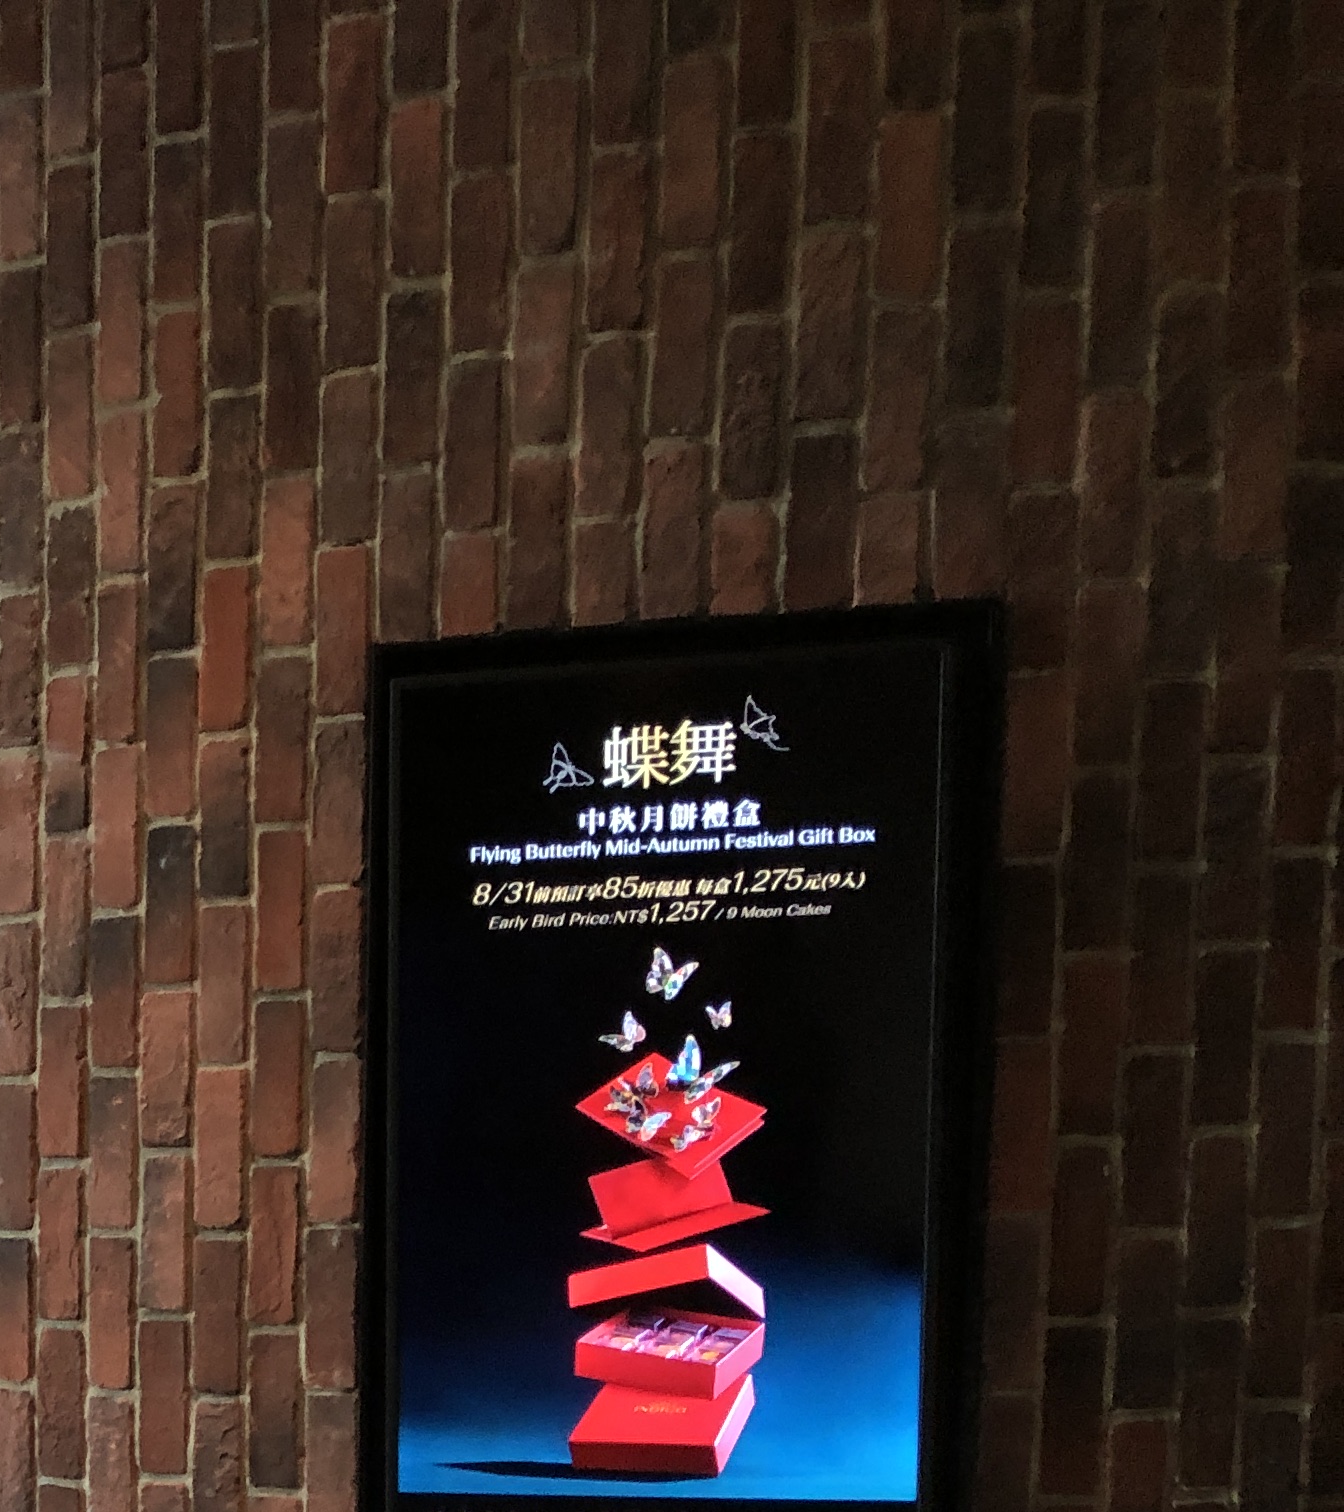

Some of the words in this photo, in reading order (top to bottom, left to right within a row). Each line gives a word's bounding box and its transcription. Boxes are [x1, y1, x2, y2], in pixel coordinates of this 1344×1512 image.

[603, 720, 737, 789] 蝶舞
[578, 799, 761, 836] 中秋月餅禮盒
[470, 845, 521, 866] Flying
[525, 840, 601, 860] Butterfly
[605, 836, 720, 857] Mid-Autumn
[723, 829, 794, 850] Festival
[797, 827, 834, 846] Gift
[838, 826, 875, 843] Box
[488, 915, 528, 931] Early
[532, 913, 565, 927] Bird
[741, 906, 782, 918] Moon
[787, 904, 831, 916] Cakes
